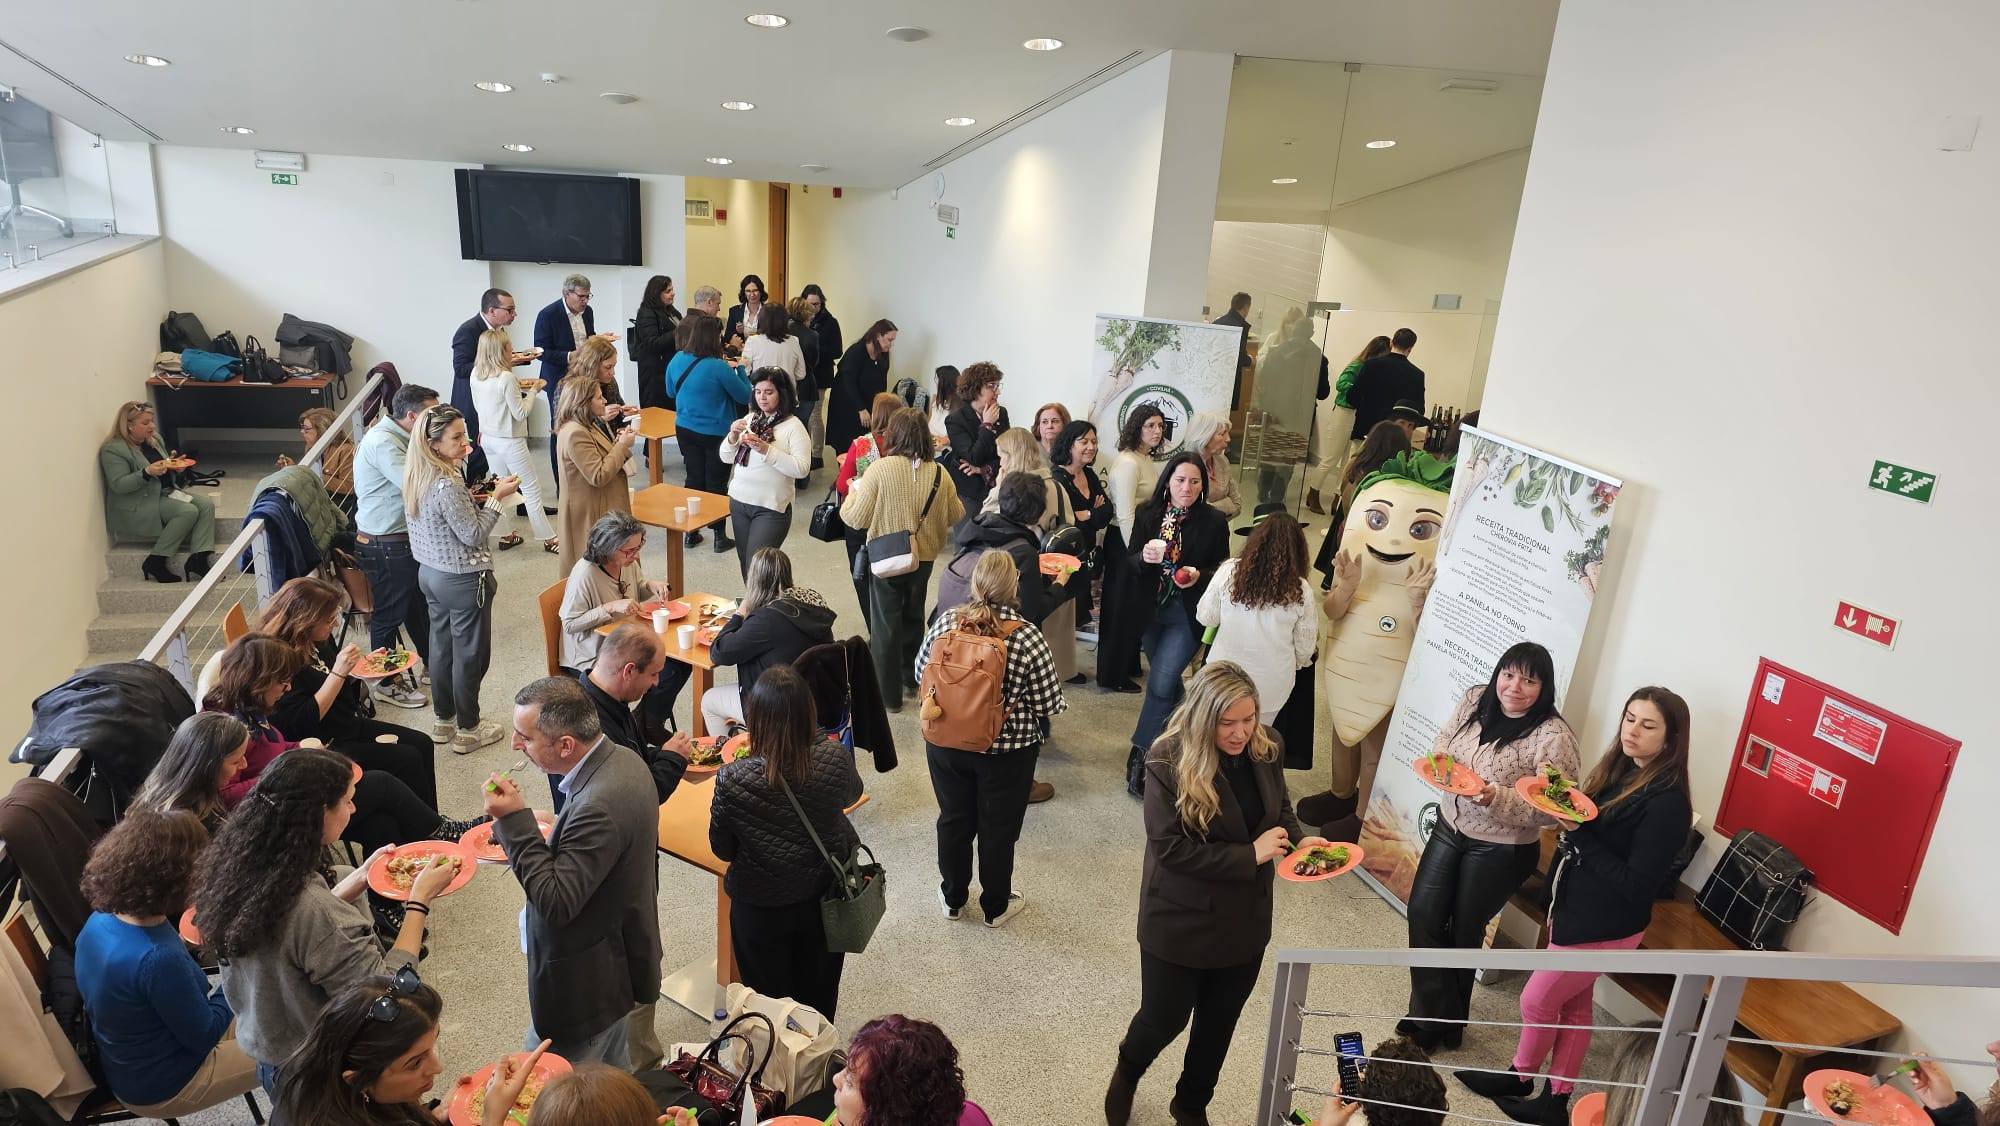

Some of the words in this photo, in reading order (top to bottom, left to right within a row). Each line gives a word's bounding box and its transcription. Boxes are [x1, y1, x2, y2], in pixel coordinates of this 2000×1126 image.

[1476, 514, 1504, 531] RECEITA
[1506, 527, 1551, 555] TRADICIONAL
[1490, 530, 1517, 549] CHEROVIA
[1517, 542, 1533, 554] FRITA
[1458, 591, 1464, 599] A
[1465, 594, 1490, 613] PANELA
[1491, 608, 1502, 619] NO
[1502, 614, 1526, 633] FORNO
[1426, 639, 1448, 655] PANELA
[1448, 651, 1457, 660] NO
[1444, 638, 1470, 658] RECEITA
[1471, 654, 1494, 674] TRADIC
